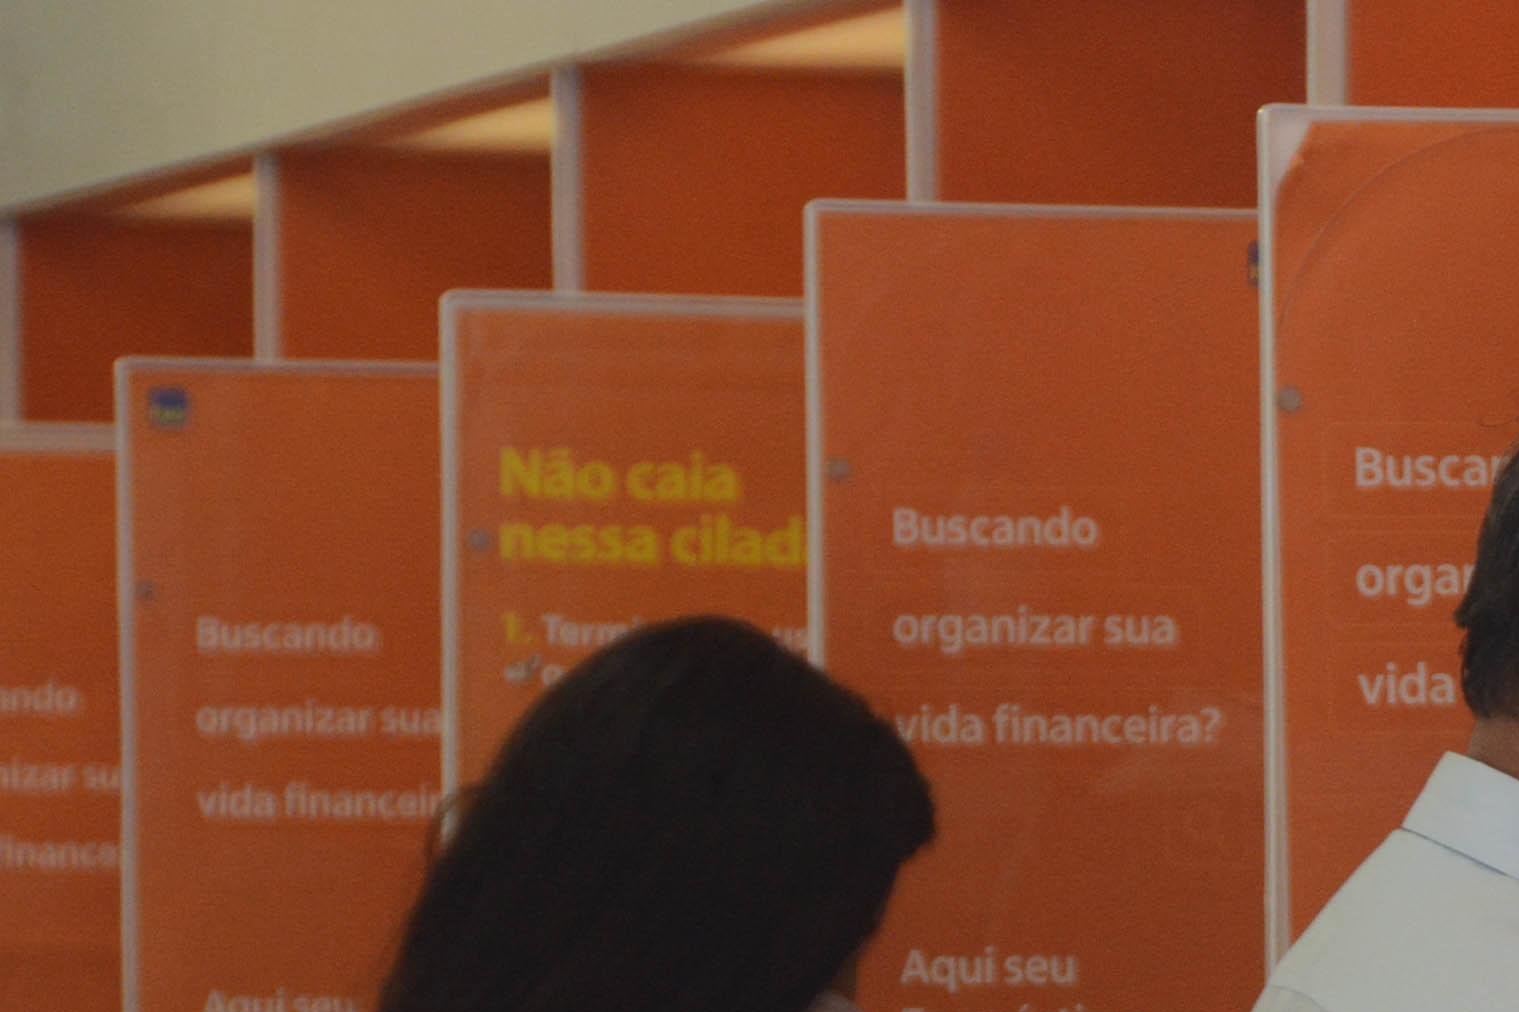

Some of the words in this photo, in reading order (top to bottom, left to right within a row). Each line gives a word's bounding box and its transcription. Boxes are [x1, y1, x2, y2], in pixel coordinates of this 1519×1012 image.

[502, 446, 615, 499] Não
[627, 451, 740, 500] caia
[502, 520, 660, 564] nessa
[893, 506, 1099, 547] Buscando
[196, 616, 381, 652] Buscando
[893, 606, 1092, 656] organizar
[1104, 614, 1178, 646] sua
[1358, 664, 1455, 705] vida
[196, 699, 374, 743] organizar
[897, 705, 986, 744] vida
[992, 704, 1222, 746] financeira?
[198, 781, 277, 818] vida
[902, 947, 996, 990] Aqui
[1004, 954, 1078, 984] seu
